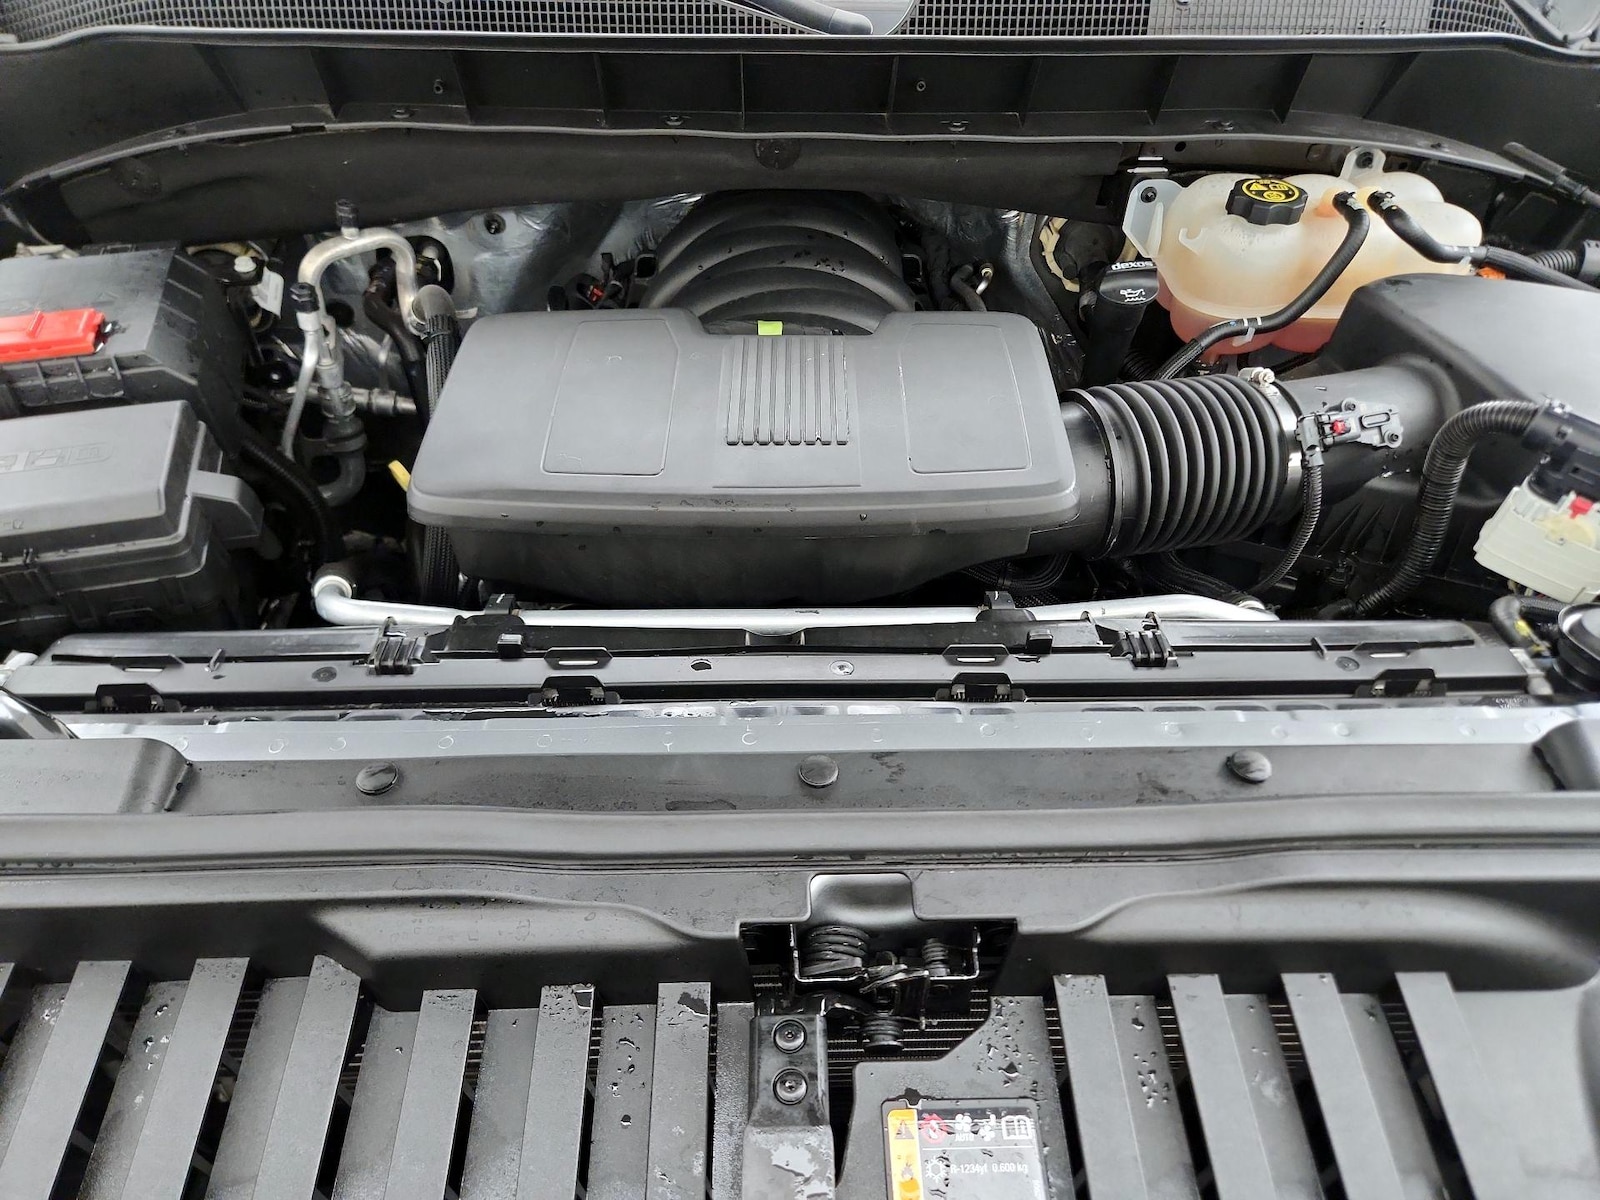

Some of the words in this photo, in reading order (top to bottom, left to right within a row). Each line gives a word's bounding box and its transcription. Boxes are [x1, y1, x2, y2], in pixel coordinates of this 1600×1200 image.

[1112, 261, 1153, 270] dexos
[955, 1132, 974, 1142] AUTO
[950, 1164, 987, 1176] R-1234yf
[992, 1163, 1015, 1172] 0.600
[1017, 1162, 1028, 1174] kg
